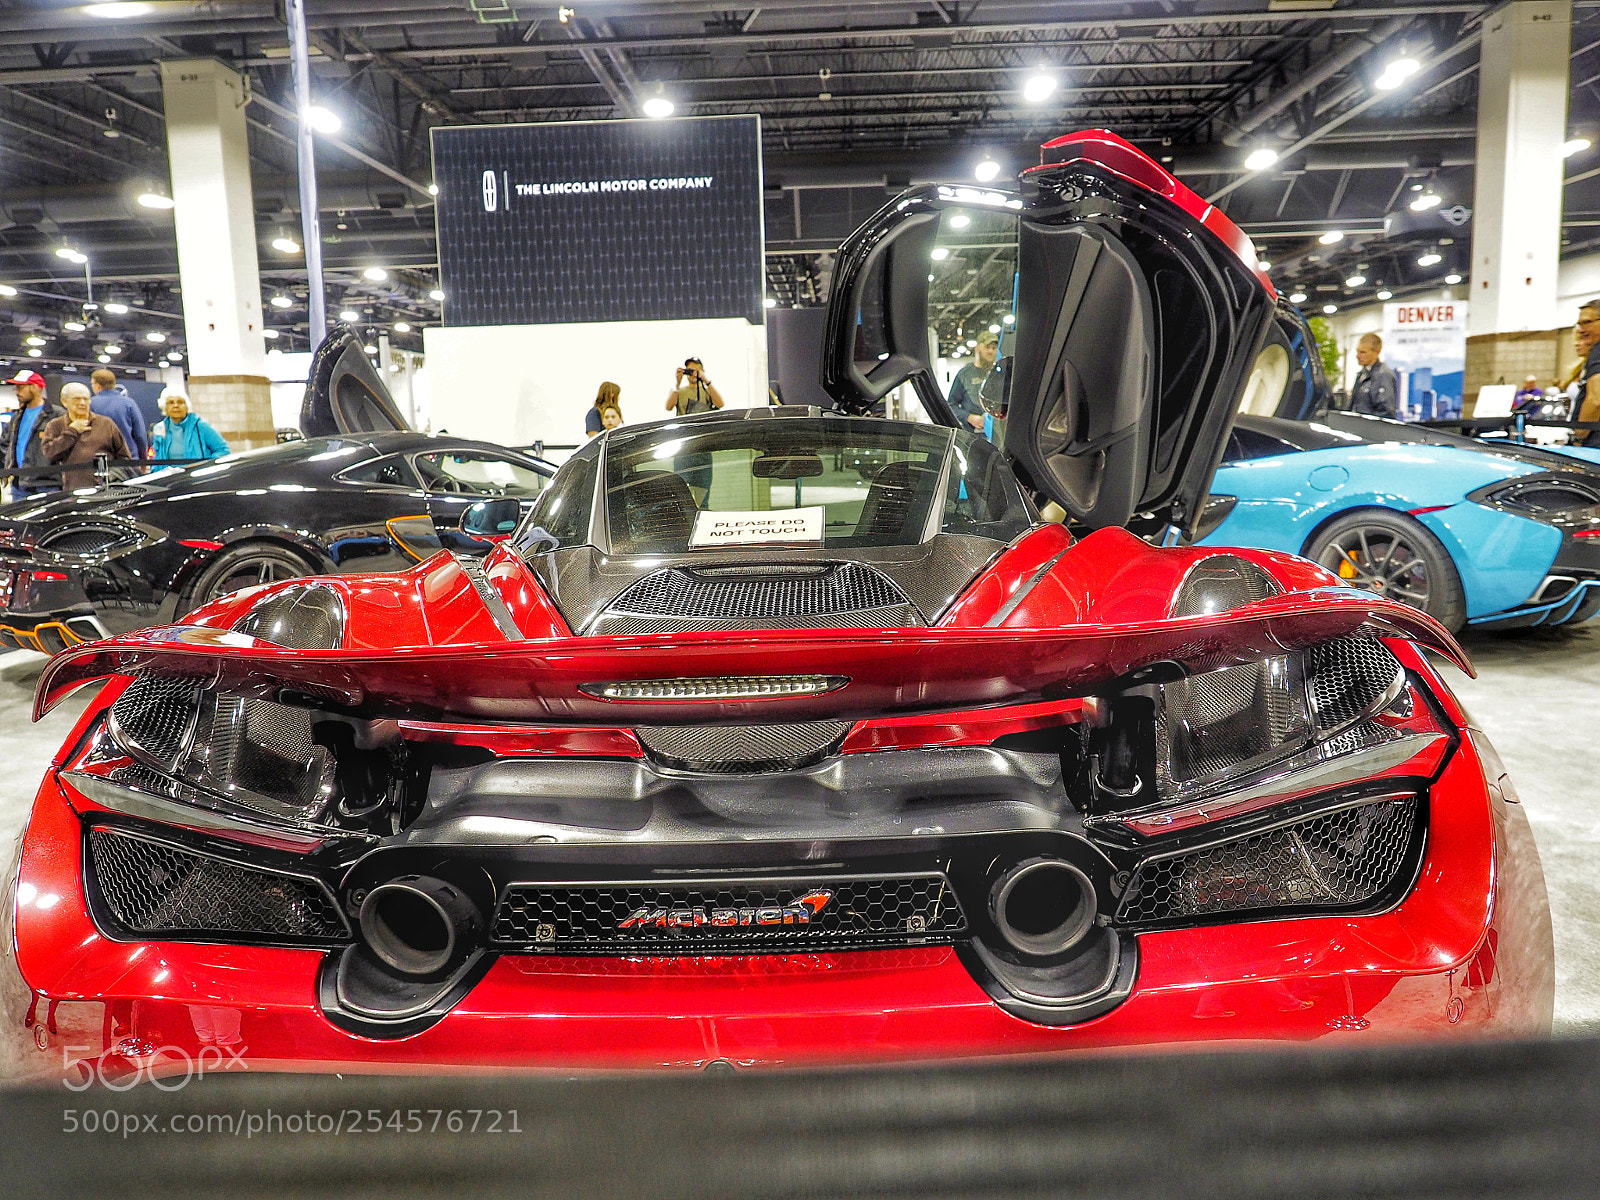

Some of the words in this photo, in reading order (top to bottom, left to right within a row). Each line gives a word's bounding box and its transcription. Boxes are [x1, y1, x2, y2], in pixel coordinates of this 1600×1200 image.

[515, 184, 541, 196] THE
[542, 181, 600, 194] LINCOLN
[600, 179, 647, 192] MOTOR
[649, 176, 713, 190] COMPANY
[1398, 306, 1454, 323] DENVER
[714, 520, 776, 528] PLEASE
[749, 527, 806, 535] TOUCH
[617, 906, 810, 928] McLaren
